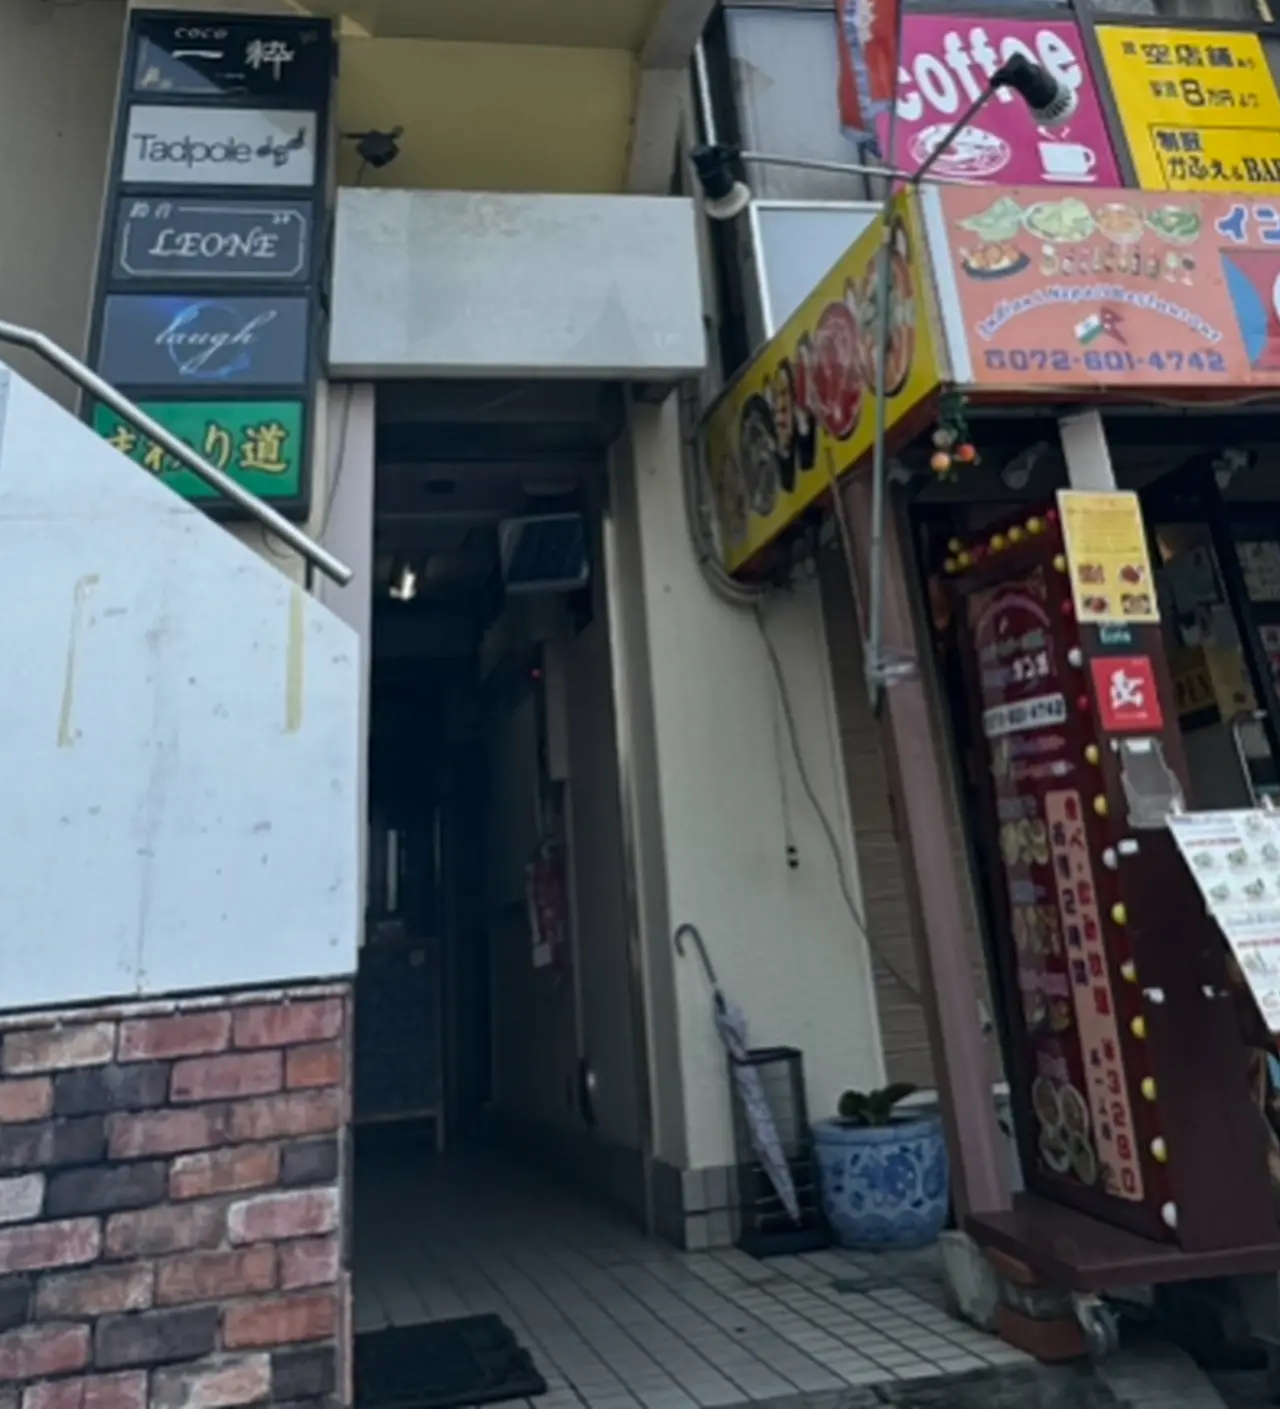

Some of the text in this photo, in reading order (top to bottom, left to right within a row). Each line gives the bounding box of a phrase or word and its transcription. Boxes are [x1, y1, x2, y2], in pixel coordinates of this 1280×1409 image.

[133, 133, 252, 167] Tadpole
[148, 227, 280, 258] LEONE
[1008, 348, 1226, 373] 072-601-4742
